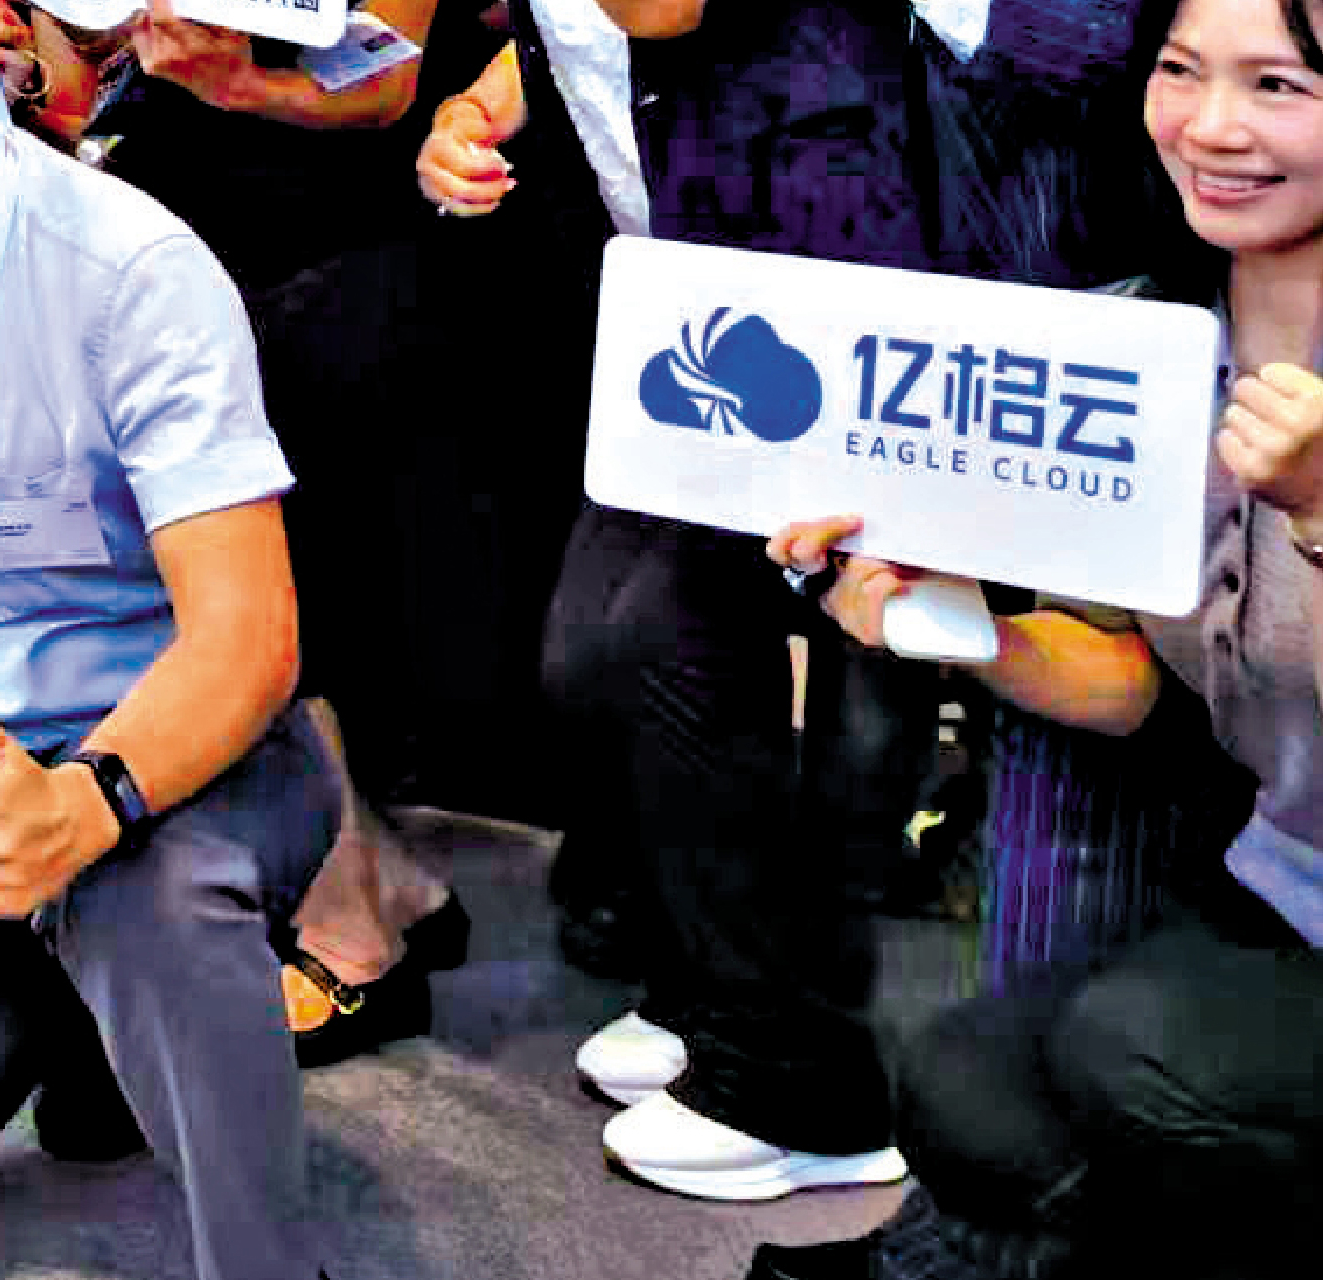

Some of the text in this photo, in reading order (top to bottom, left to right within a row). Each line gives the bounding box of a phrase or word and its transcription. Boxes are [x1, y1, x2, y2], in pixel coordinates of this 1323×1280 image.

[853, 334, 1140, 464] 亿格云
[845, 431, 1132, 503] EAGLE CLOUD
